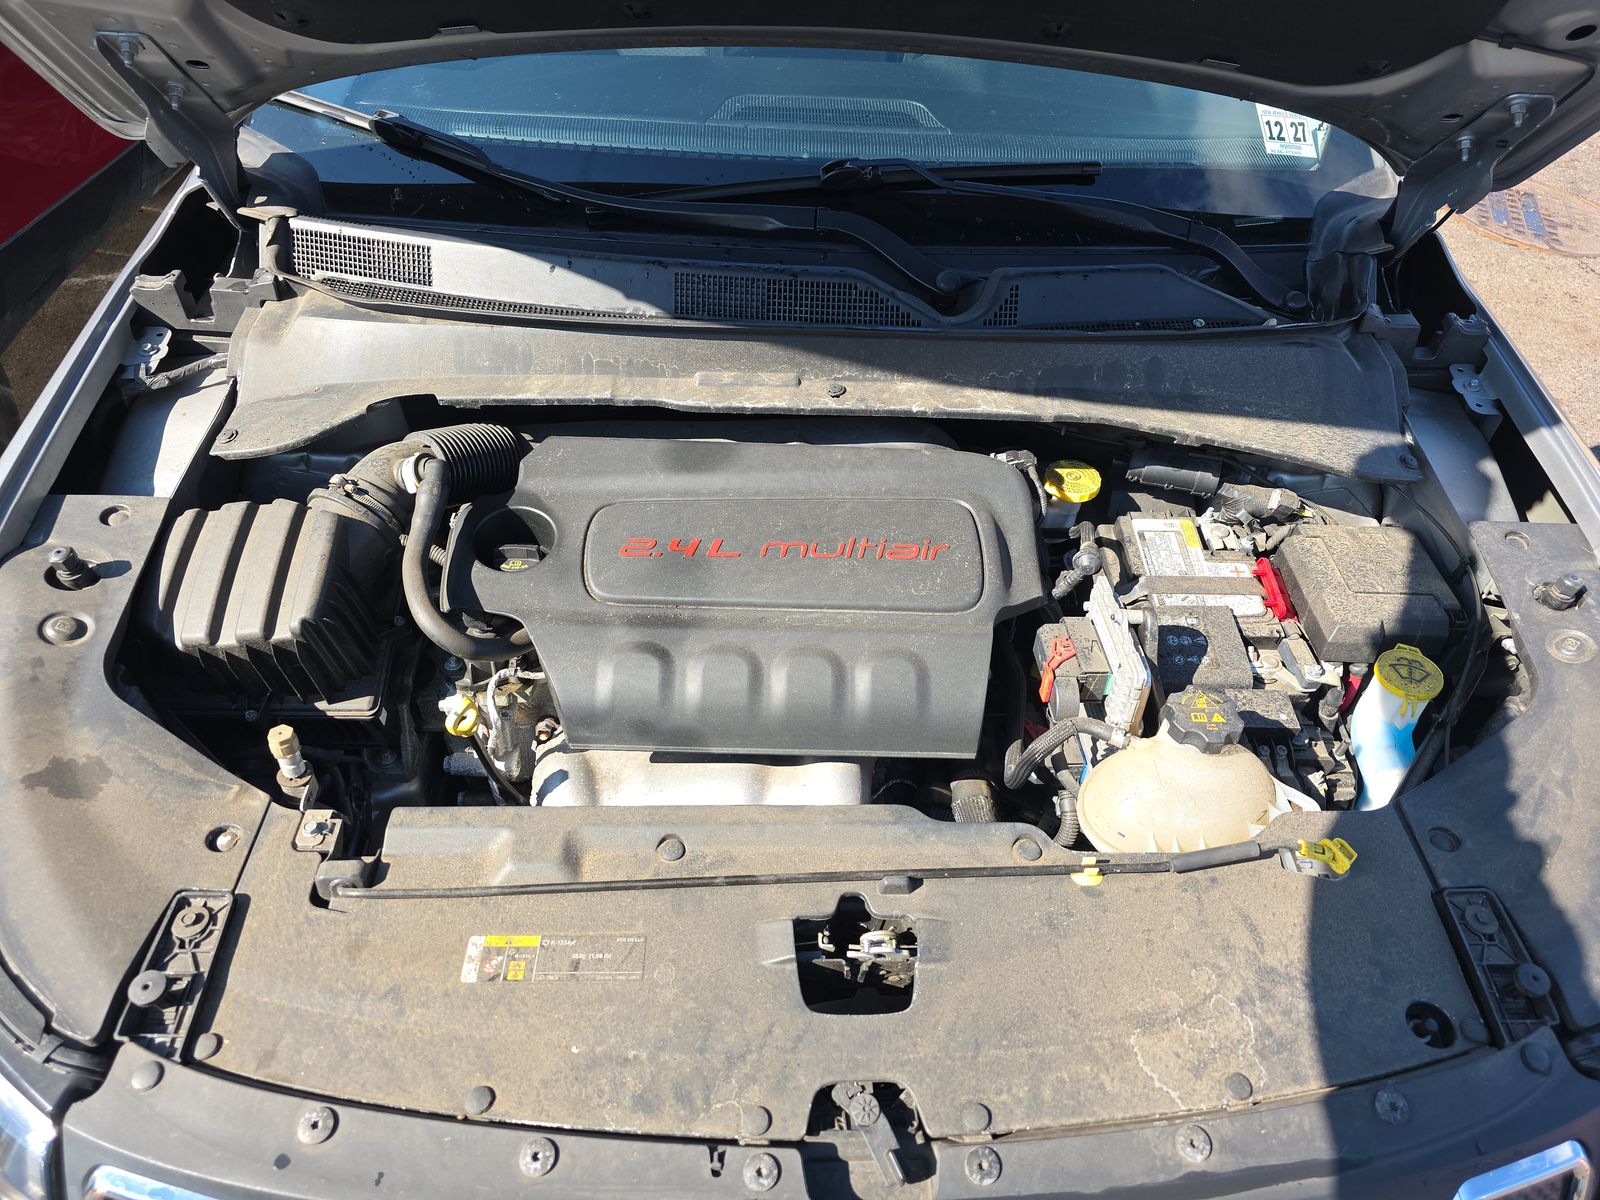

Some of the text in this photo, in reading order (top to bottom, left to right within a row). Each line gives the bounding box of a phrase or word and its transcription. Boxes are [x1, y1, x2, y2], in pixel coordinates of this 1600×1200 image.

[1265, 120, 1286, 141] 12
[1290, 121, 1307, 142] 27
[759, 536, 951, 560] multiair
